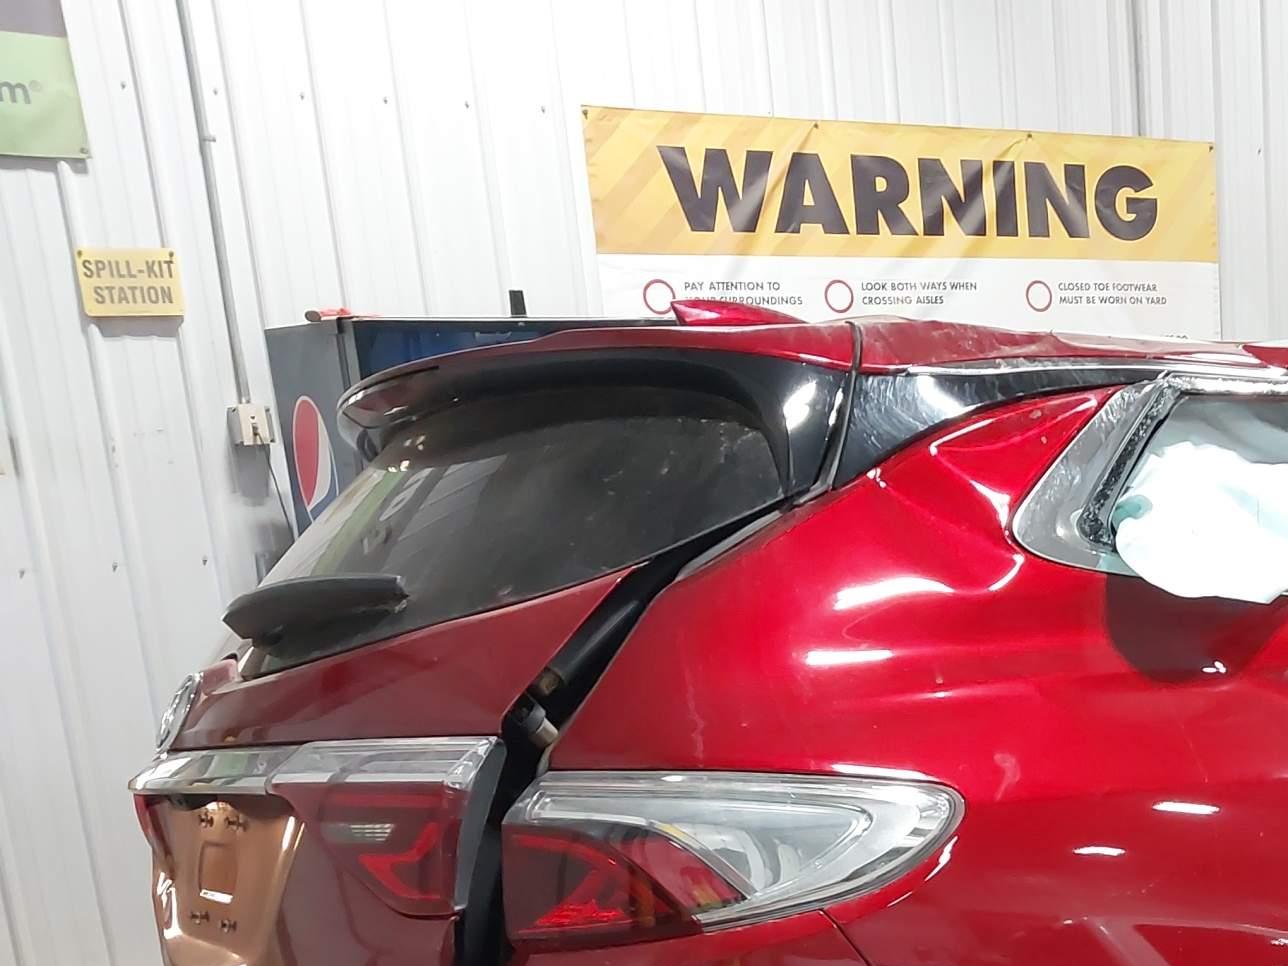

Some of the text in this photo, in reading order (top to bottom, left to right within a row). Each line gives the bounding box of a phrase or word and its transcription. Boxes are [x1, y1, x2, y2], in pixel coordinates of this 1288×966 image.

[656, 145, 1158, 242] WARNING
[82, 259, 175, 279] SPILL-KIT
[684, 281, 781, 291] PAY ATTENTION TO
[861, 281, 978, 292] LOOK BOTH WAYS WHEN
[1058, 282, 1158, 292] CLOSED TOE FOOTWEAR
[93, 286, 174, 305] STATION
[862, 295, 945, 305] CROSSING AISLES
[1059, 295, 1167, 305] MUST BE WORN ON YARD
